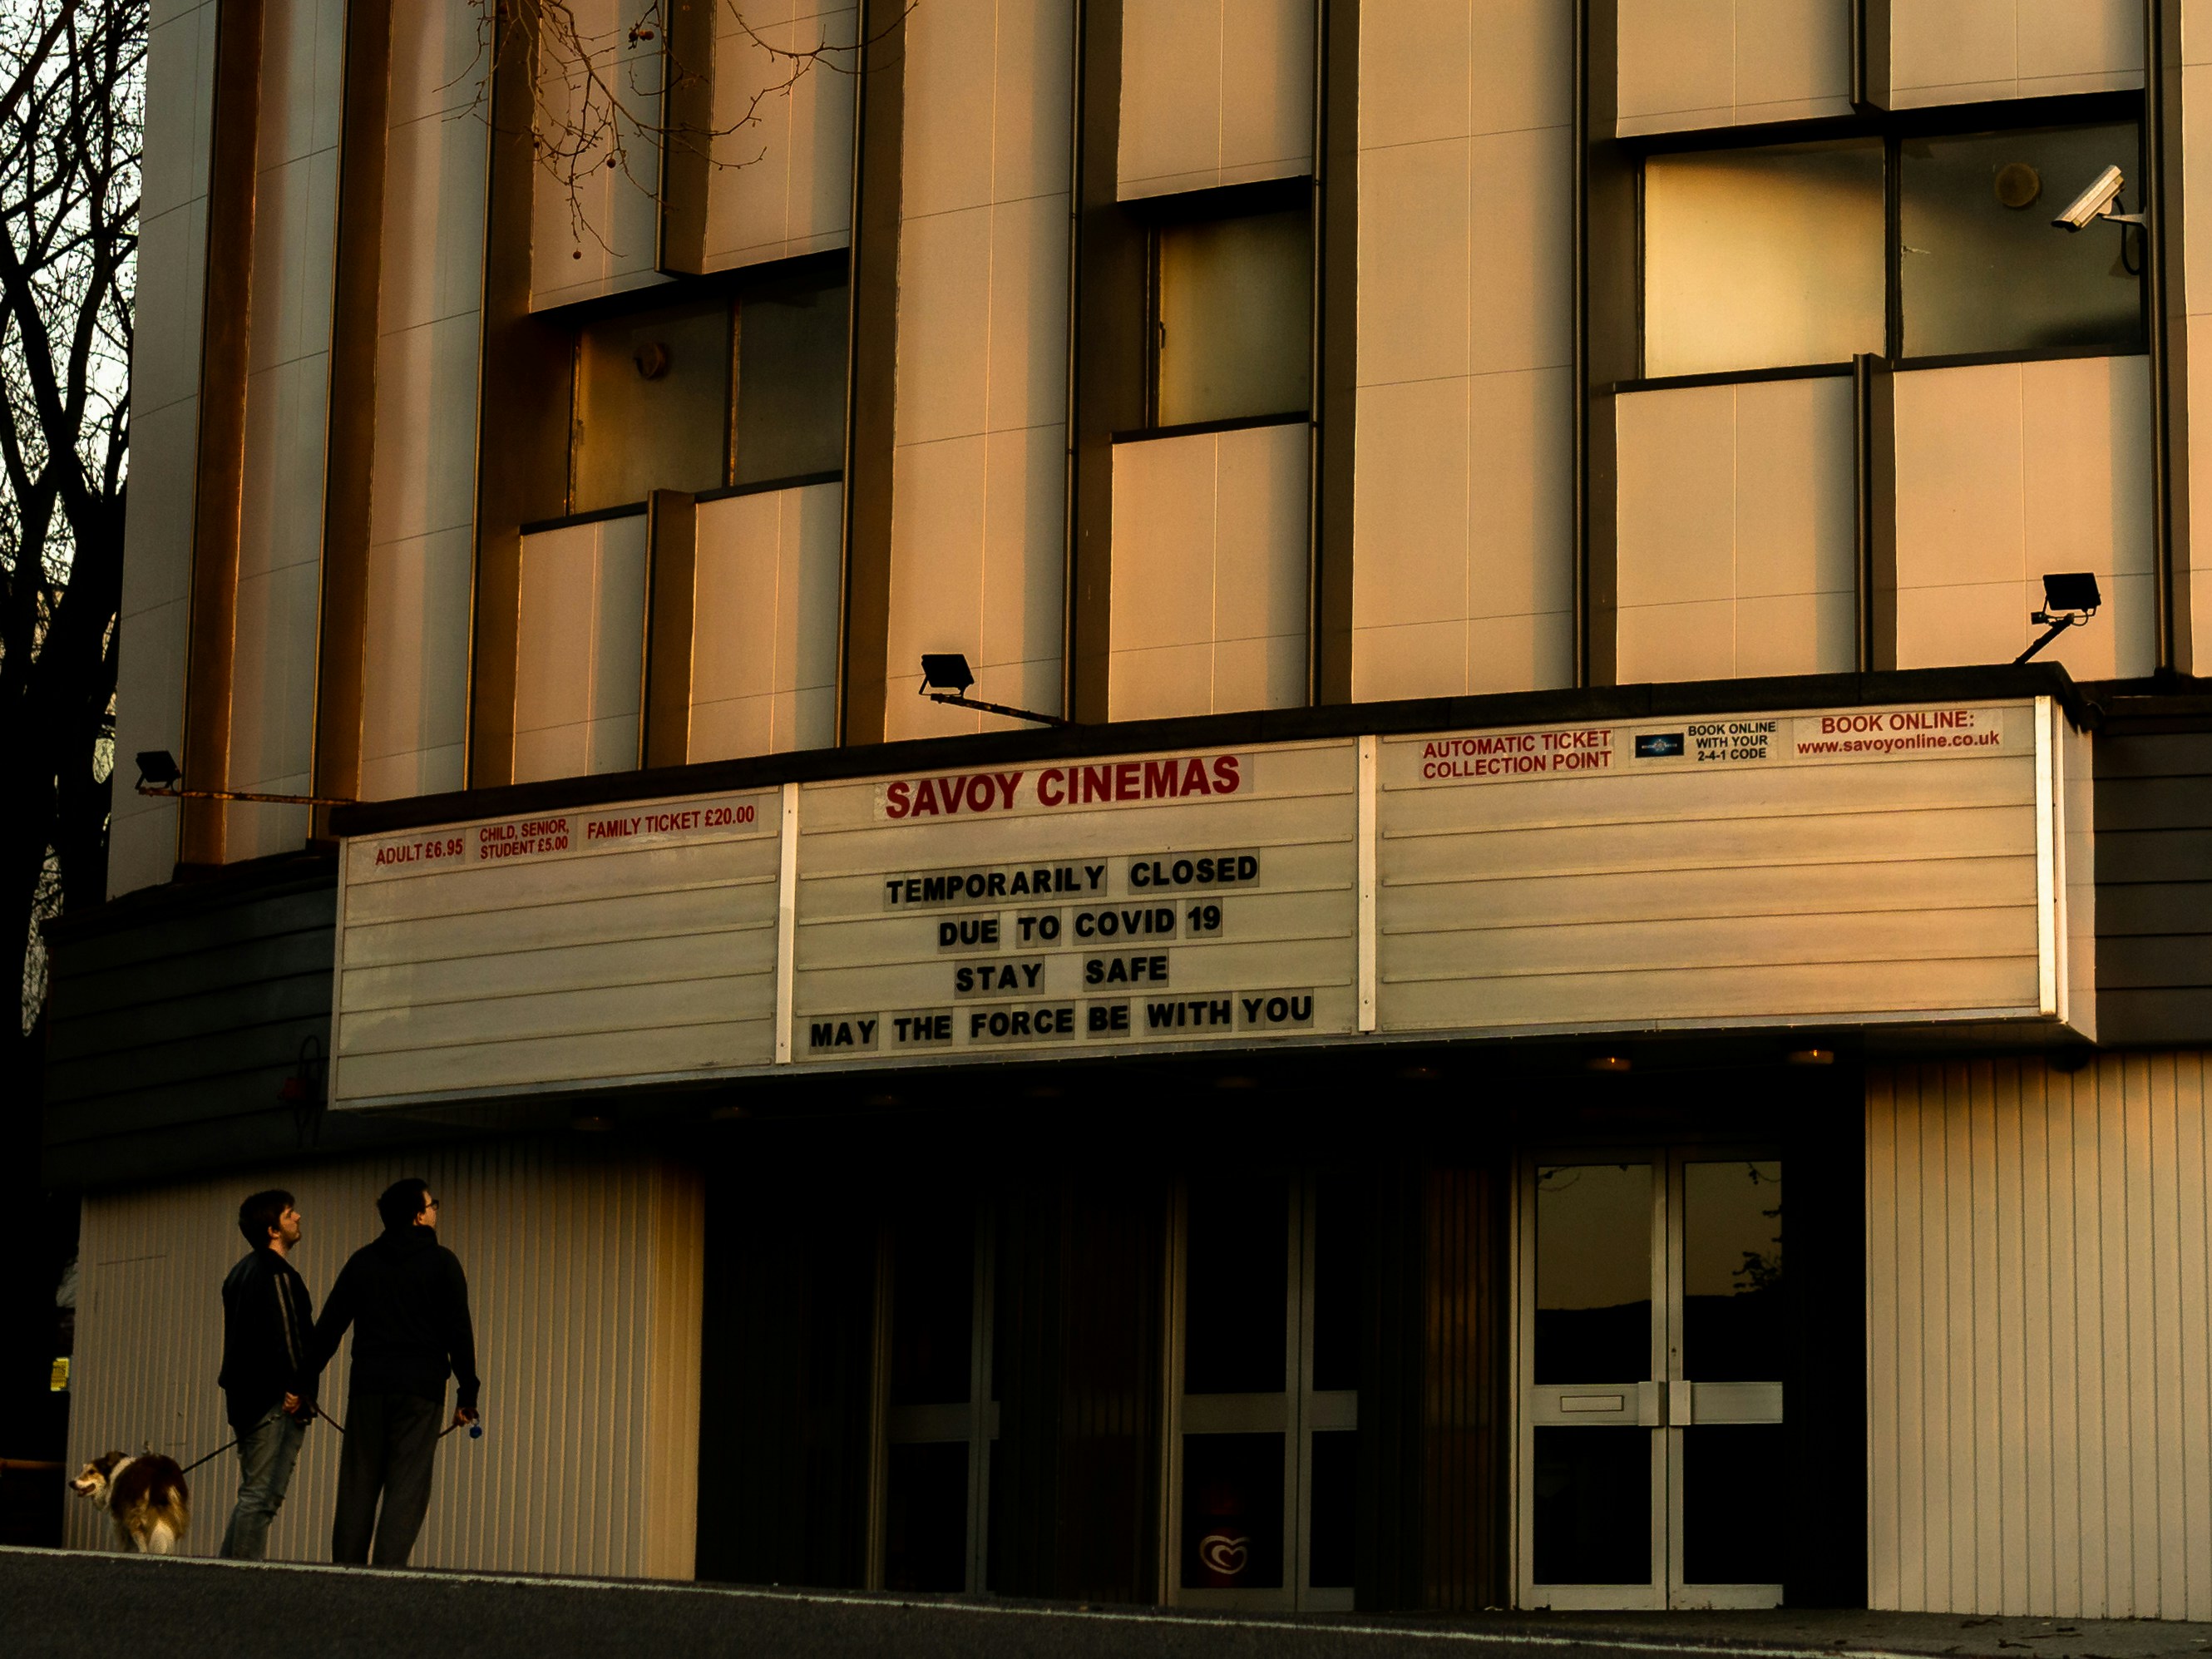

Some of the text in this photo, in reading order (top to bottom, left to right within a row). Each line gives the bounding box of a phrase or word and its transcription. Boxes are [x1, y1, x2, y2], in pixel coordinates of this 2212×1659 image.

[1688, 722, 1776, 736] BOOK ONLINE
[1822, 711, 1974, 734] BOOK ONLINE:
[1424, 730, 1611, 758] AUTOMATIC TICKET
[1696, 735, 1768, 748] WITH YOUR
[1698, 748, 1766, 761] 2-4-1 CODE
[1798, 731, 2000, 753] www.savoyonline.co.uk
[1424, 751, 1612, 778] COLLECTION POINT
[886, 757, 1239, 818] SAVOY CINEMAS
[480, 819, 569, 842] CHILD, SENIOR,
[588, 805, 754, 839] FAMILY TICKET £20.00
[376, 838, 463, 865] ADULT £6.95
[481, 836, 568, 859] STUDENT £5.00
[886, 856, 1257, 903] TEMPORARILY CLOSED
[940, 906, 1220, 946] DUE TO COVID 19
[956, 956, 1168, 991] STAY SAFE
[811, 996, 1312, 1047] MAY THE FORCE BE WITH YOU
